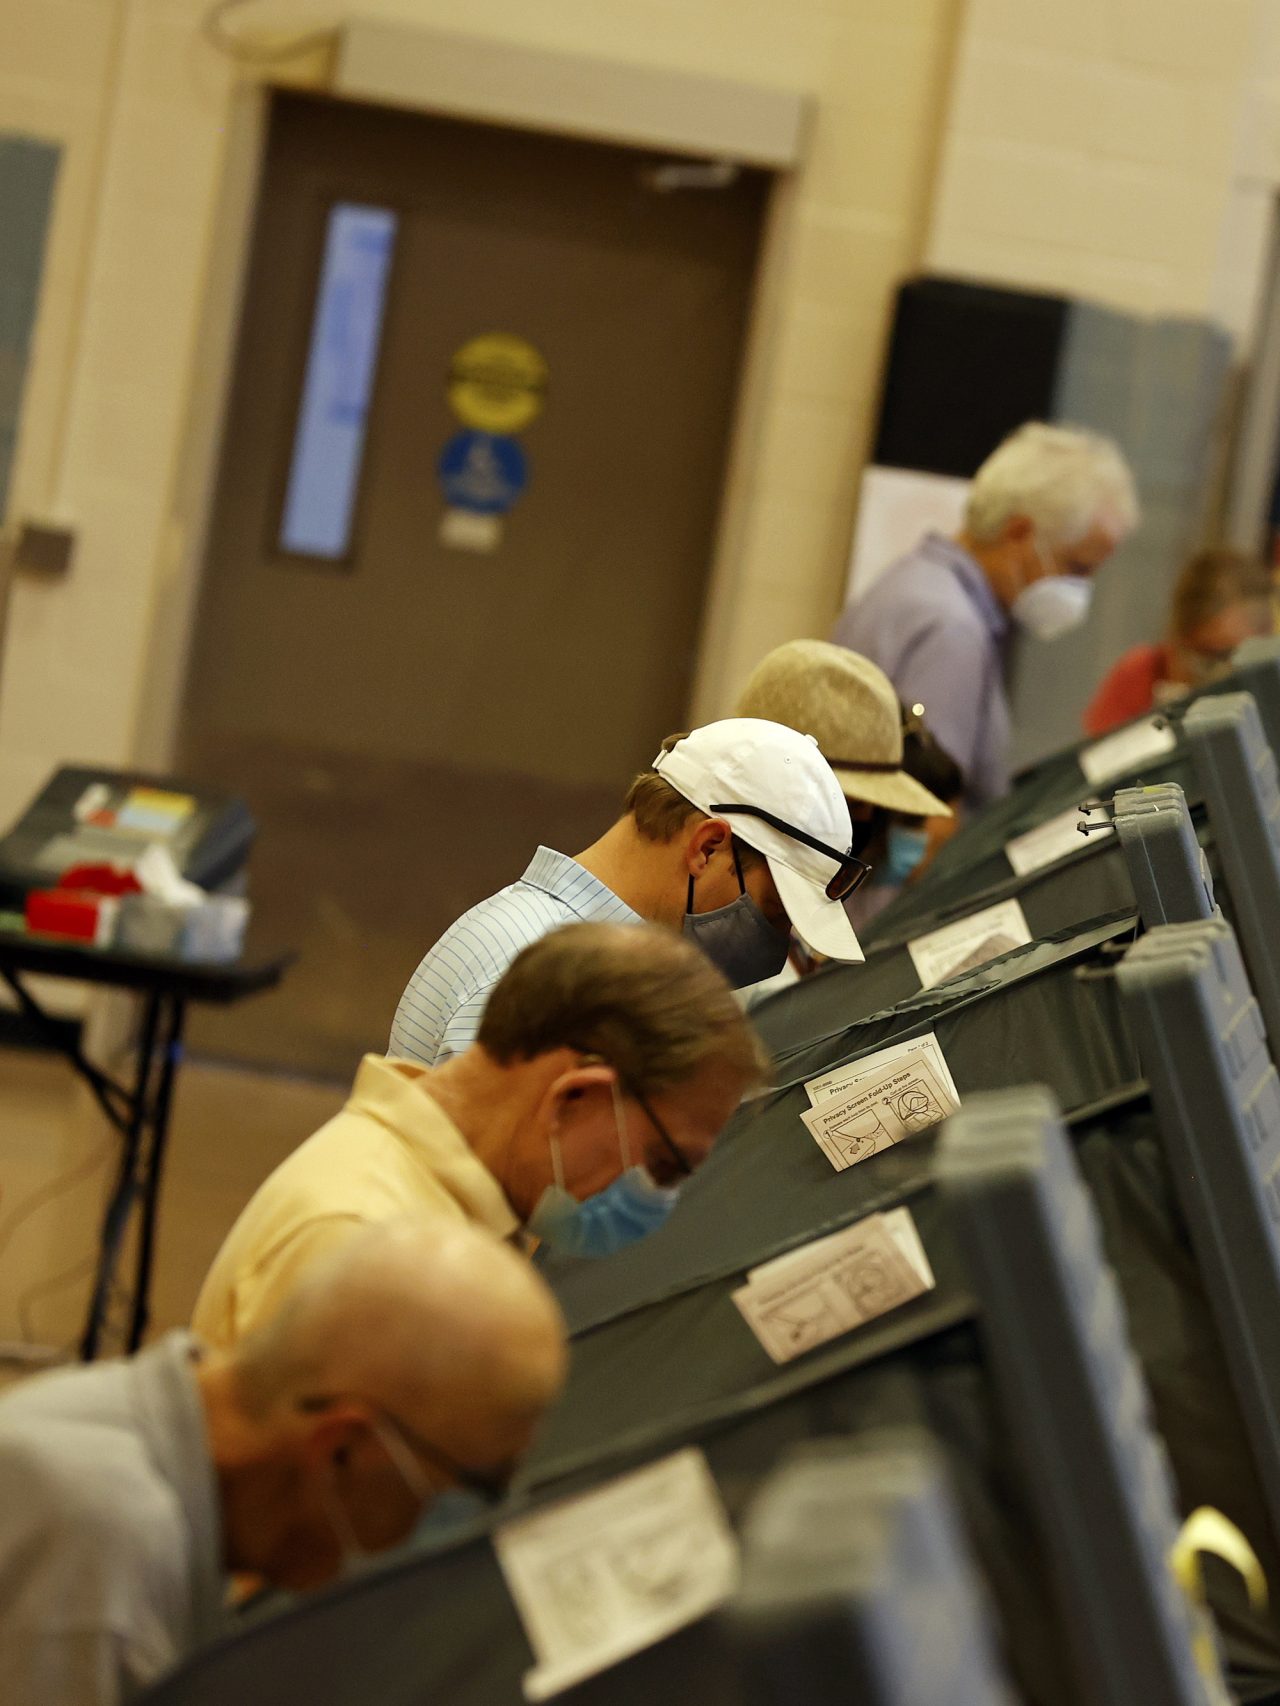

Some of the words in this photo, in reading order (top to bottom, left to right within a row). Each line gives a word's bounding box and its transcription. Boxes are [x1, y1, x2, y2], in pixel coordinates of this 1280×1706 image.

[823, 1109, 847, 1124] Privacy
[846, 1096, 869, 1111] Screen
[868, 1083, 893, 1099] Fold-Up
[892, 1072, 911, 1085] Steps
[882, 1097, 891, 1105] 2
